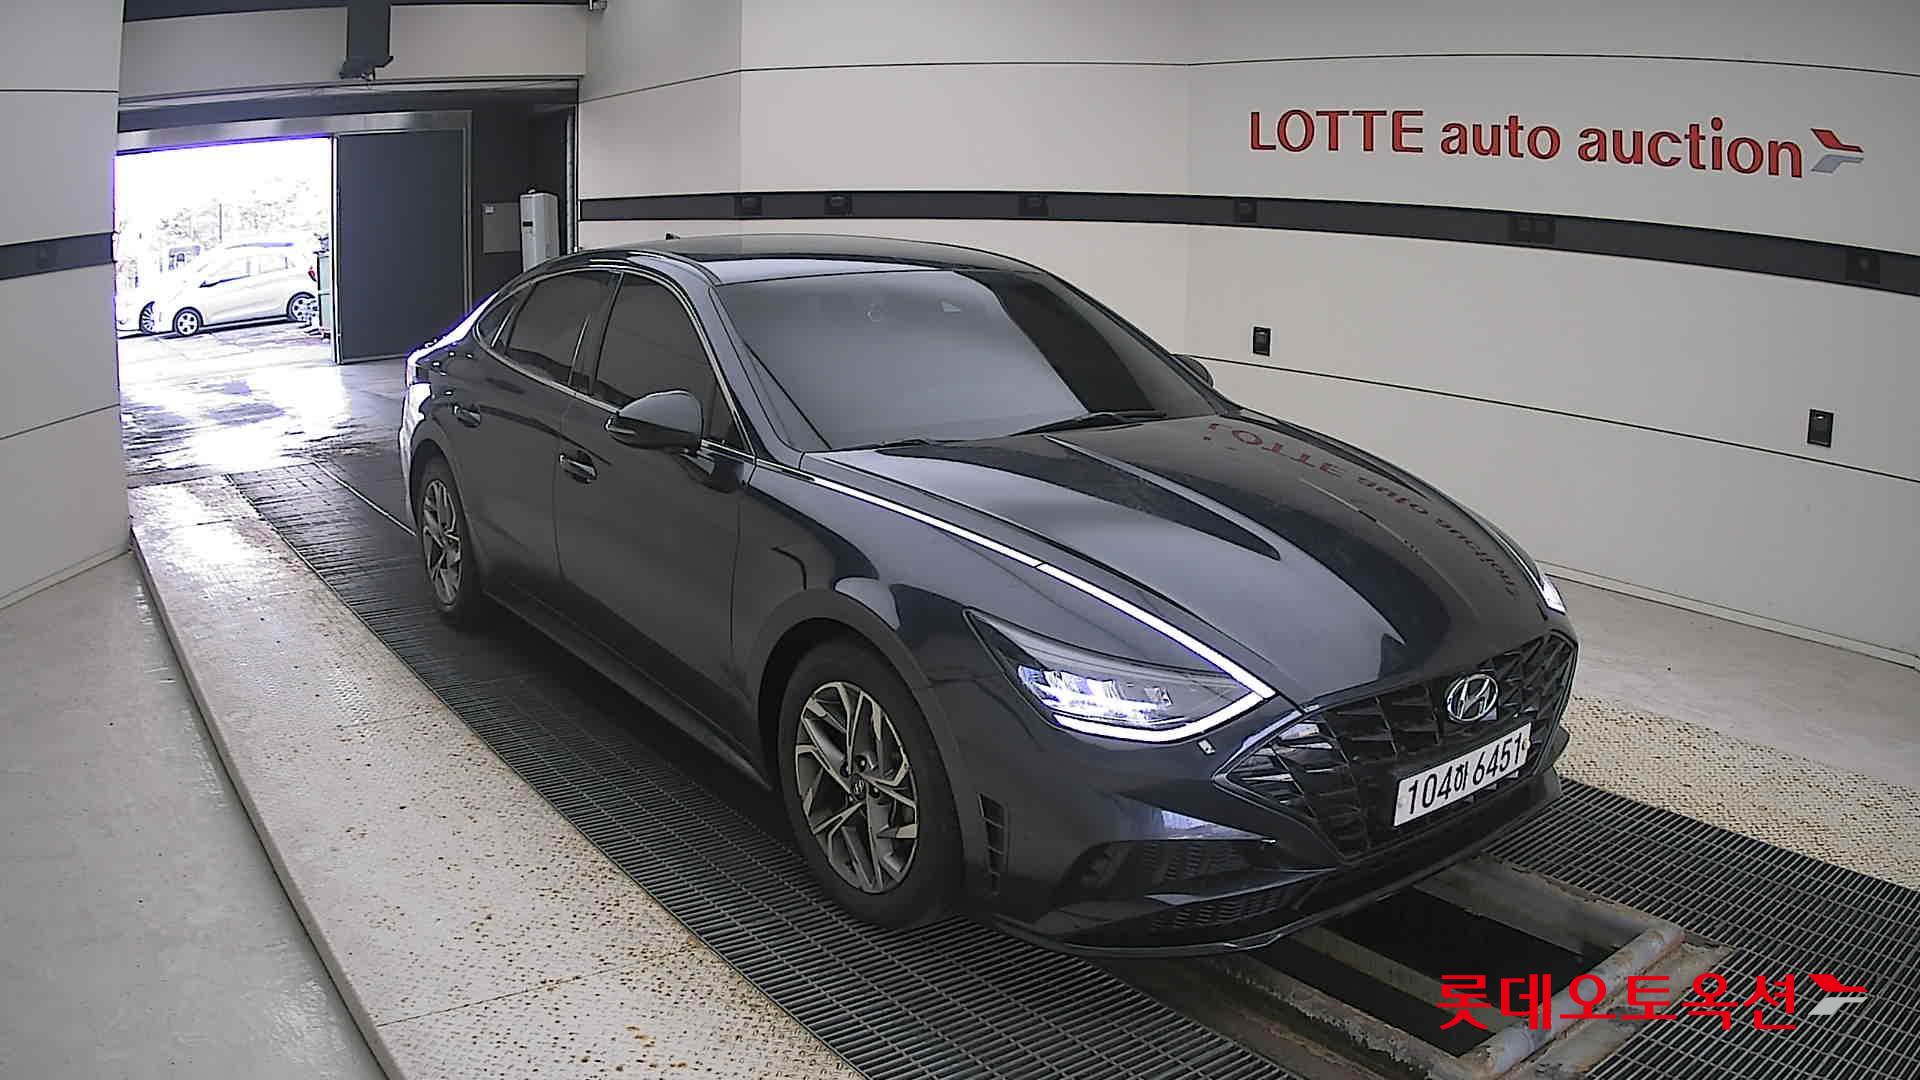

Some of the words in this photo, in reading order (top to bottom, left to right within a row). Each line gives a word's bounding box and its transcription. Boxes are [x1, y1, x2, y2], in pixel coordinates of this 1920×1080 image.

[1250, 109, 1425, 153] LOTTE
[1440, 115, 1561, 160] auto
[1577, 117, 1802, 178] auction
[1472, 732, 1523, 786] 6451
